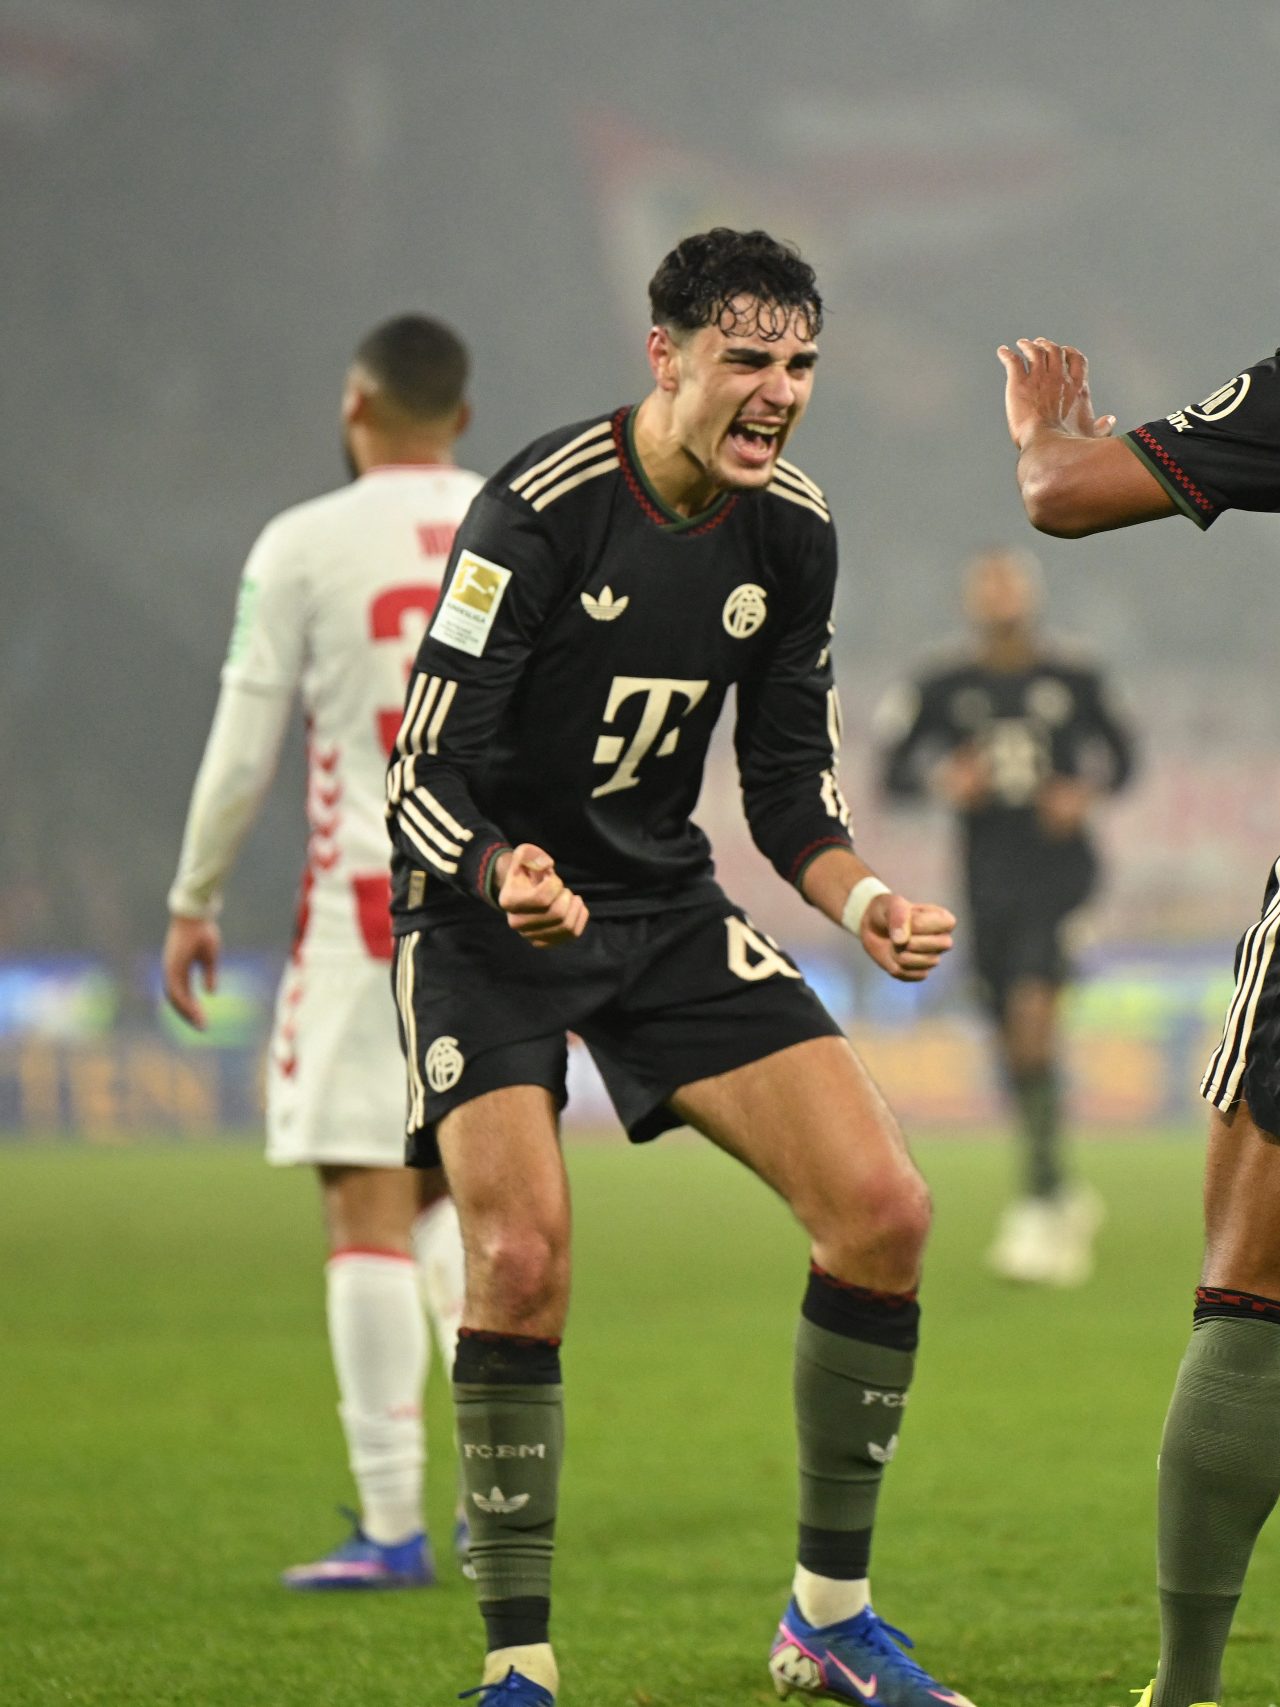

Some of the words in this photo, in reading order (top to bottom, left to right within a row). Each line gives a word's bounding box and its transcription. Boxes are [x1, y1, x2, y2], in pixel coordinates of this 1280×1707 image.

[590, 676, 709, 799] T
[724, 914, 802, 981] 4
[463, 1443, 545, 1459] FCBM
